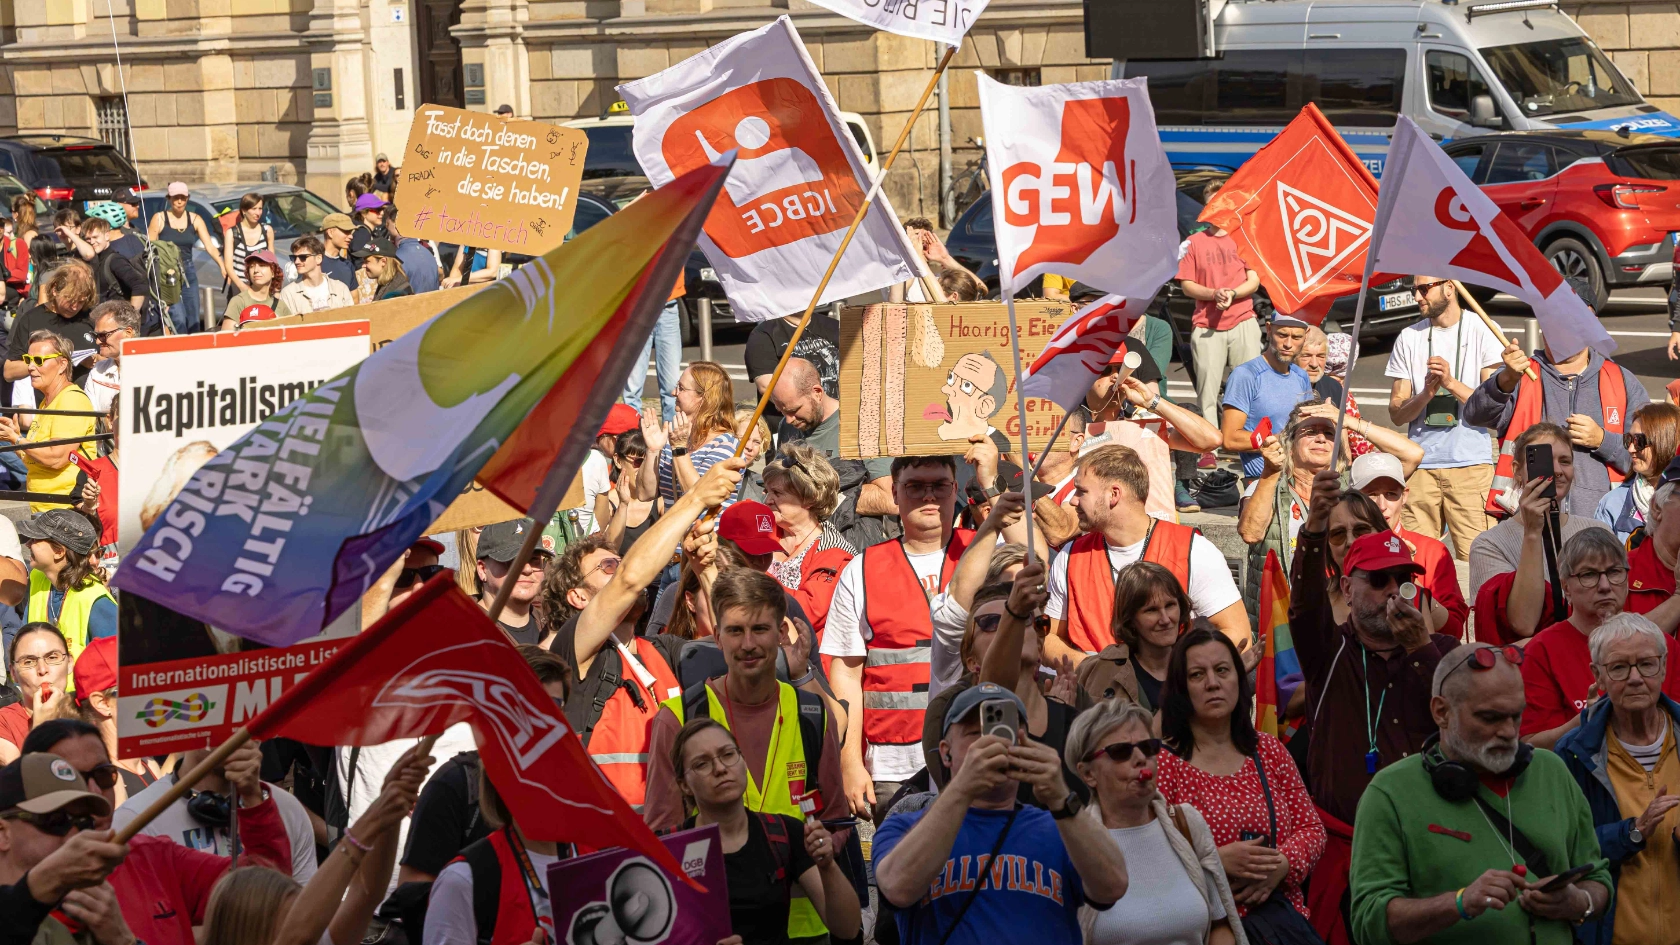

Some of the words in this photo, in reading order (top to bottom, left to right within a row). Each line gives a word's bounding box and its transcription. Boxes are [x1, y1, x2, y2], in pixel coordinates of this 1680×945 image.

[425, 111, 461, 138] Fasst
[461, 119, 493, 143] doch
[496, 125, 537, 150] denen
[1610, 118, 1672, 131] POLIZEI
[408, 169, 435, 183] PRADA
[438, 147, 452, 165] in
[454, 146, 476, 168] die
[481, 146, 551, 182] Taschen,
[458, 173, 480, 197] die
[482, 183, 505, 200] sie
[509, 181, 569, 210] haben!
[1002, 161, 1136, 227] GEW
[1386, 296, 1401, 308] HBS
[221, 376, 351, 597] VIELFÄLTIG
[132, 652, 305, 688] Internationalistische
[684, 857, 704, 870] DGB
